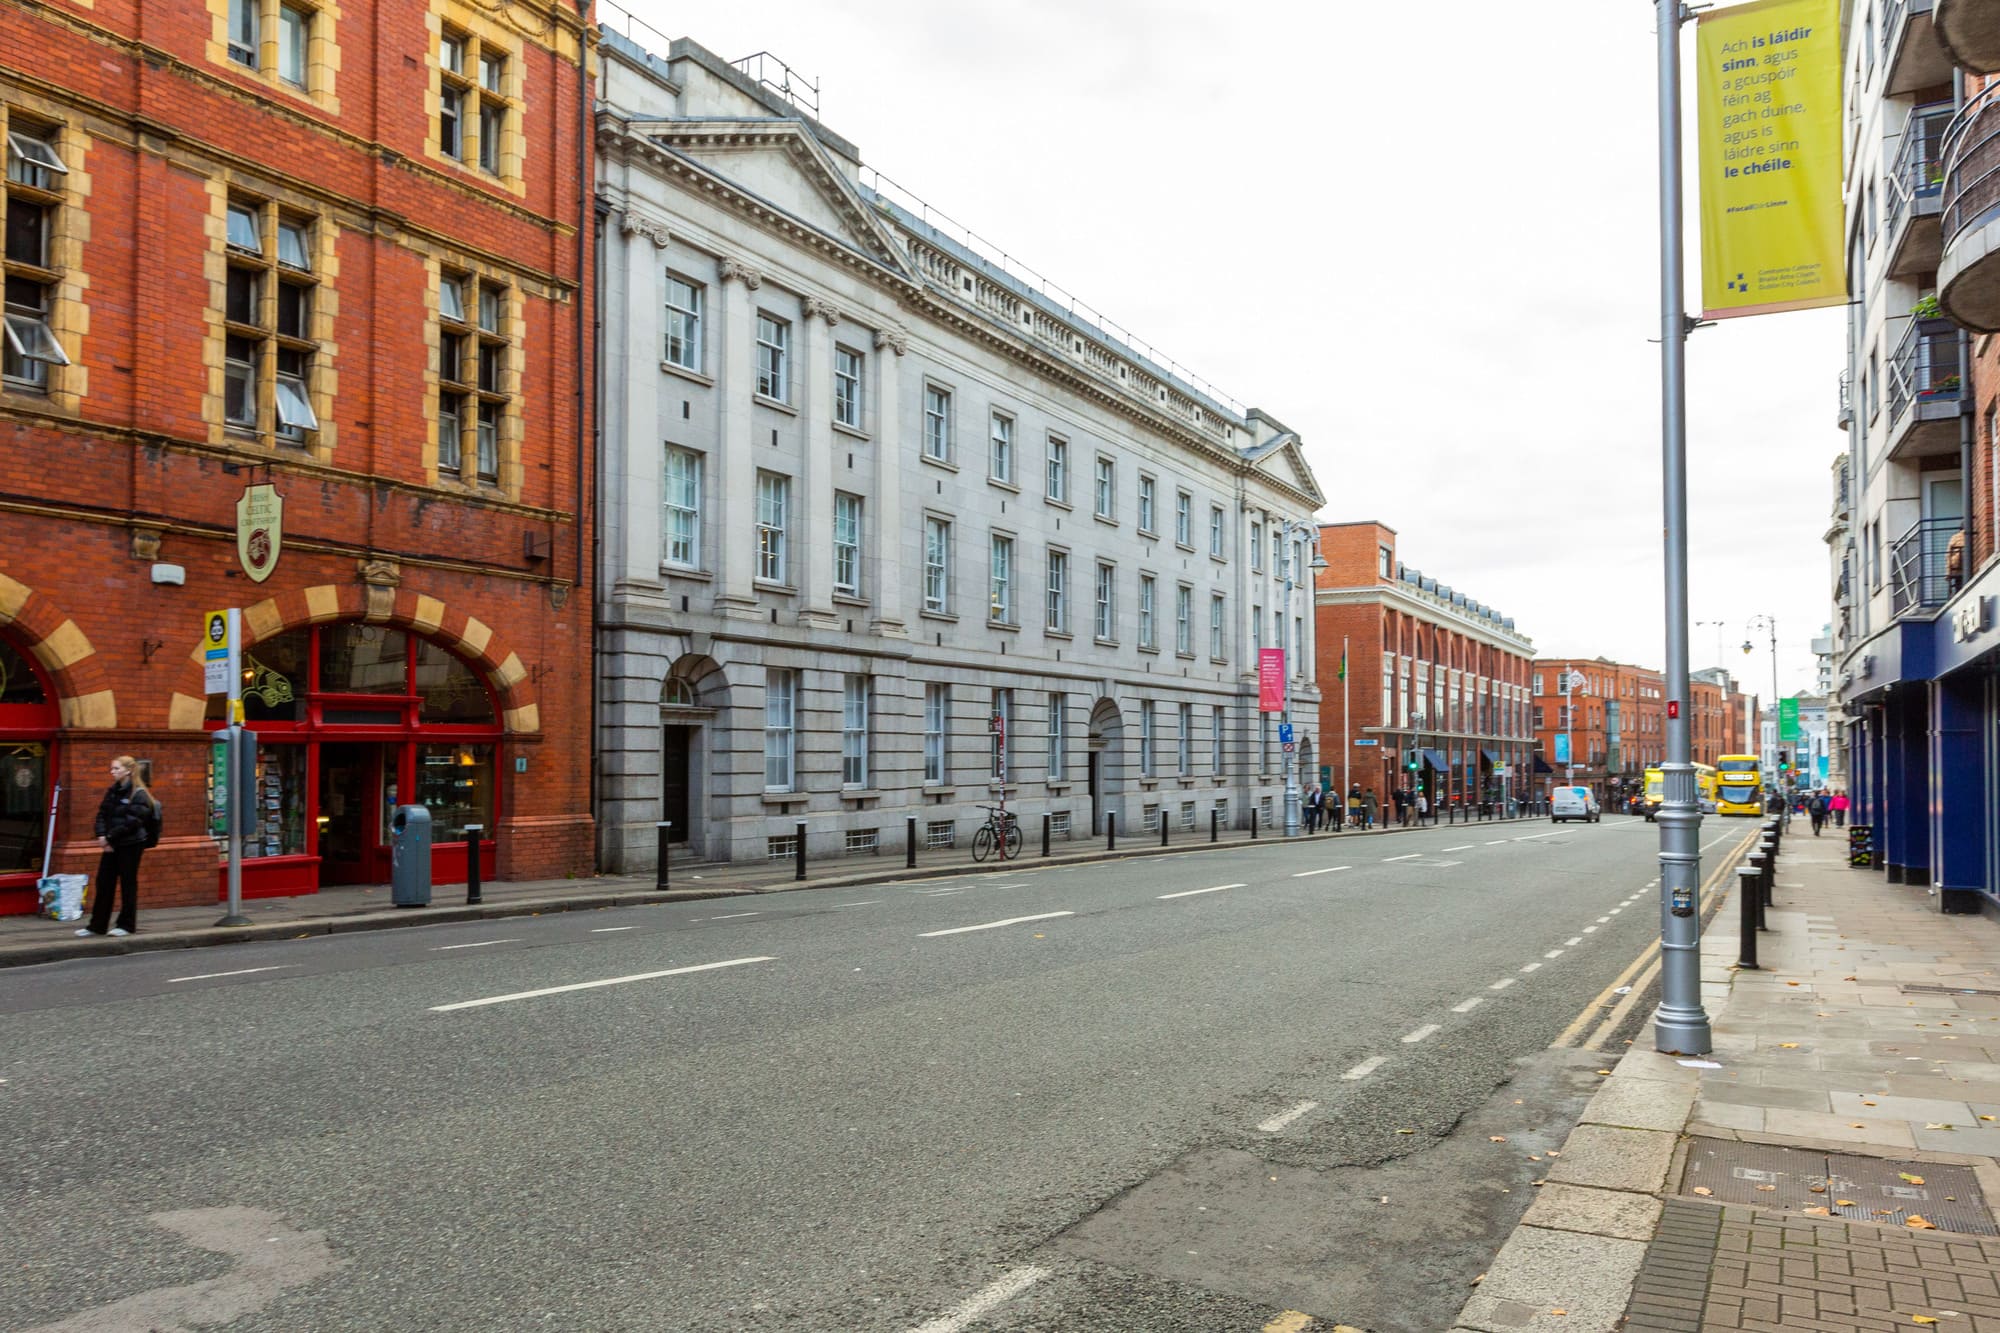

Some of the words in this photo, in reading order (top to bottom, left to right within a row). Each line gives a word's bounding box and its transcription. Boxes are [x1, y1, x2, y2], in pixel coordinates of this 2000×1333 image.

[1721, 40, 1748, 54] Ach
[1752, 36, 1765, 48] is
[1769, 27, 1812, 45] láidir
[1763, 49, 1798, 66] agus
[1722, 80, 1731, 90] a
[1735, 67, 1797, 91] gcuspóir
[1723, 93, 1750, 107] féin
[1754, 90, 1772, 104] ag
[1723, 109, 1757, 128] gach
[1723, 129, 1758, 145] agus
[1761, 126, 1773, 136] is
[1724, 145, 1765, 160] láidre
[1769, 140, 1799, 153] sinn
[1724, 166, 1739, 179] le
[1743, 158, 1795, 175] chéile.
[1282, 725, 1289, 734] P
